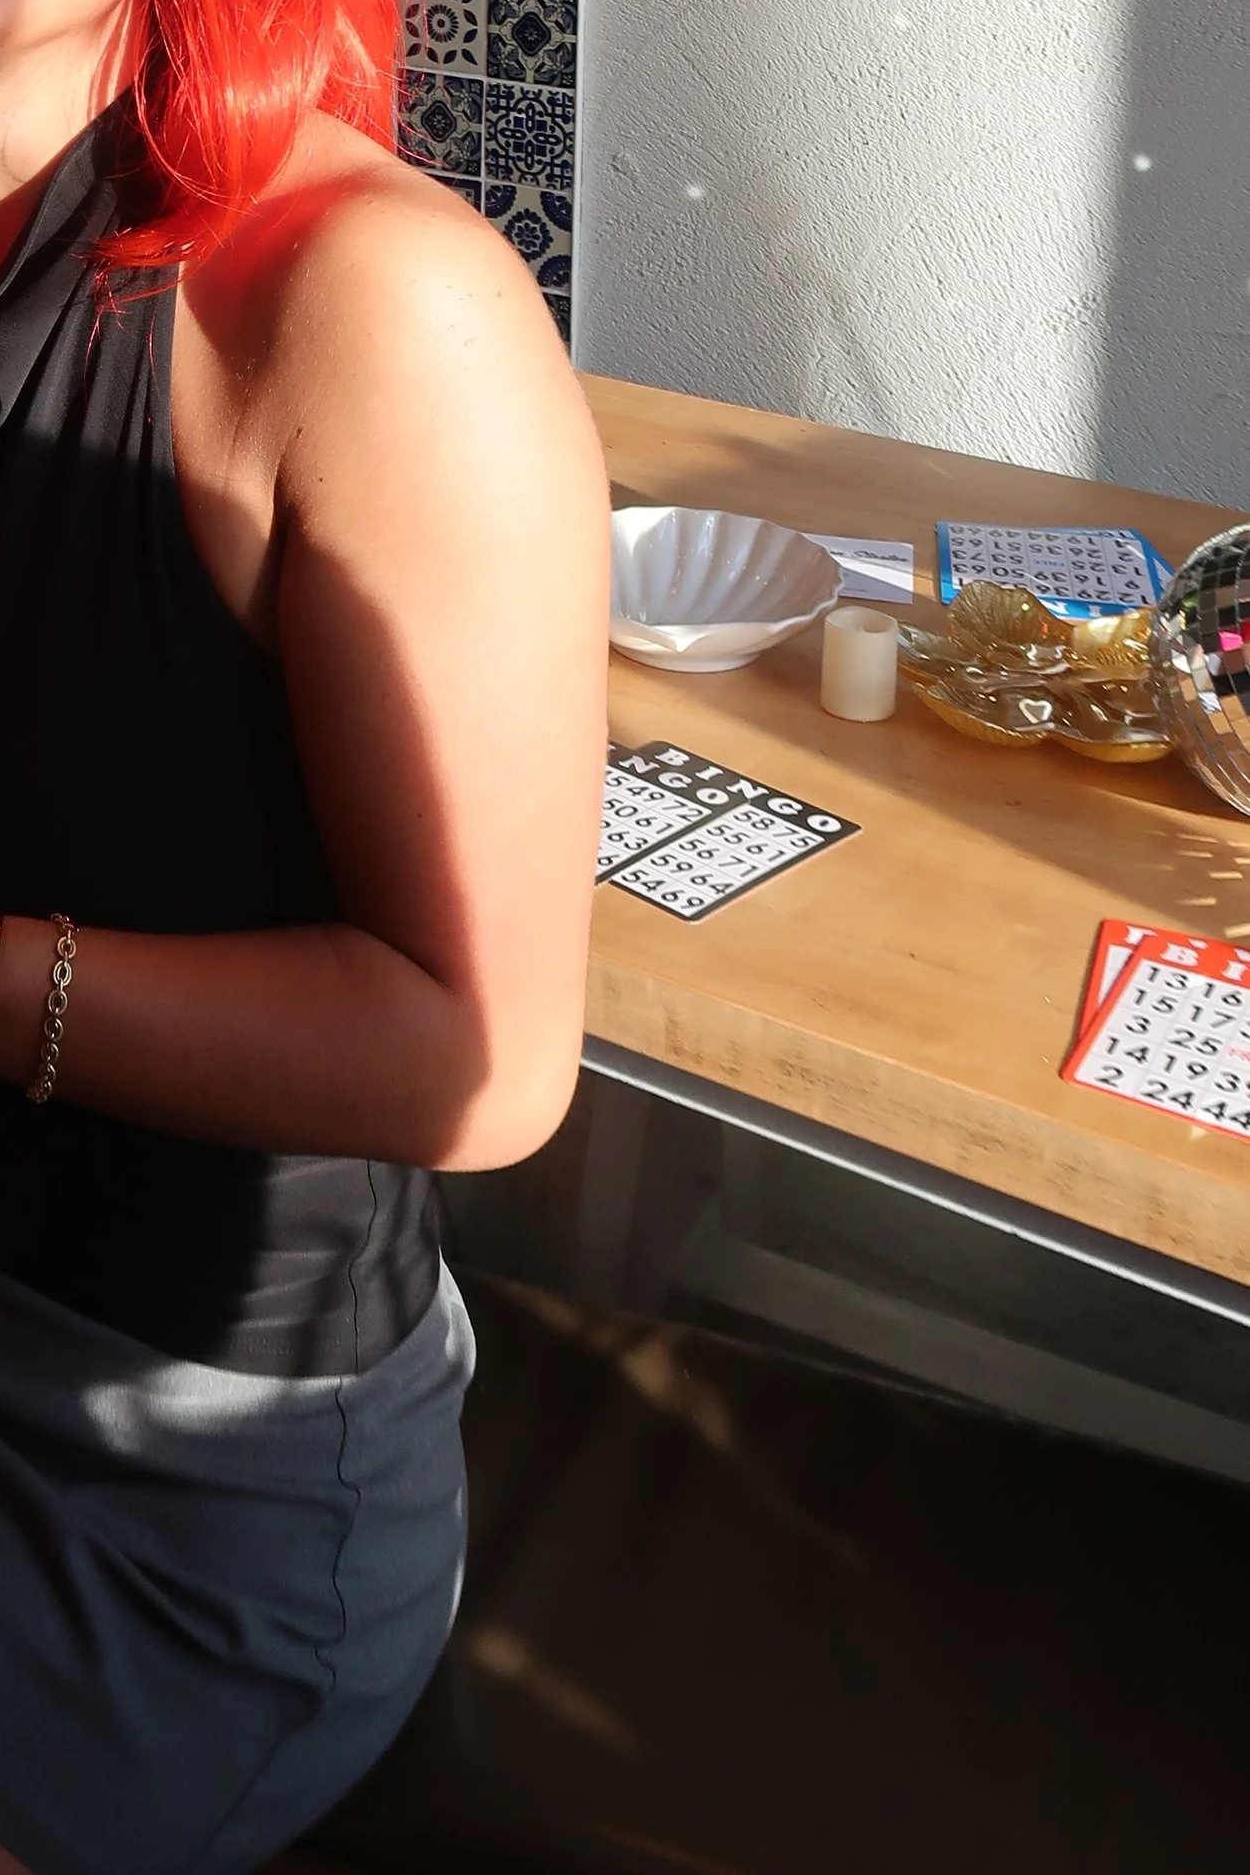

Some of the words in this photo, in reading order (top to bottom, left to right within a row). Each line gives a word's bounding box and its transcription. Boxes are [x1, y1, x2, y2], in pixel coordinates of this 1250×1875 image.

[951, 537, 983, 548] 65
[993, 541, 1022, 551] 51
[1028, 544, 1062, 555] 35
[951, 550, 985, 561] 73
[991, 553, 1024, 565] 53
[1069, 547, 1102, 559] 26
[1118, 551, 1134, 562] 2
[952, 563, 986, 574] 63
[992, 566, 1025, 579] 50
[1071, 560, 1105, 572] 25
[1112, 564, 1143, 576] 13
[1075, 574, 1108, 586] 16
[1036, 585, 1071, 597] 36
[1077, 589, 1113, 601] 29
[1118, 592, 1149, 605] 12
[608, 743, 730, 806] NGO
[654, 747, 843, 833] BINGO
[626, 784, 666, 802] 49
[661, 799, 703, 823] 72
[603, 798, 638, 818] 50
[635, 816, 674, 835] 61
[733, 809, 776, 831] 58
[772, 826, 819, 849] 75
[607, 831, 649, 851] 63
[706, 825, 751, 846] 55
[746, 842, 788, 863] 61
[678, 838, 721, 861] 56
[718, 855, 761, 878] 71
[650, 853, 694, 874] 59
[690, 873, 736, 896] 64
[621, 869, 668, 893] 54
[660, 889, 706, 911] 69
[1146, 966, 1189, 991] 13
[1202, 982, 1243, 1007] 16
[1133, 988, 1179, 1014] 15
[1189, 1004, 1236, 1029] 17
[1124, 1014, 1152, 1035] 3
[1167, 1028, 1224, 1056] 25
[1106, 1036, 1151, 1064] 14
[1162, 1054, 1209, 1081] 19
[1094, 1065, 1125, 1088] 2
[1140, 1080, 1195, 1110] 24
[1201, 1101, 1250, 1130] 44
